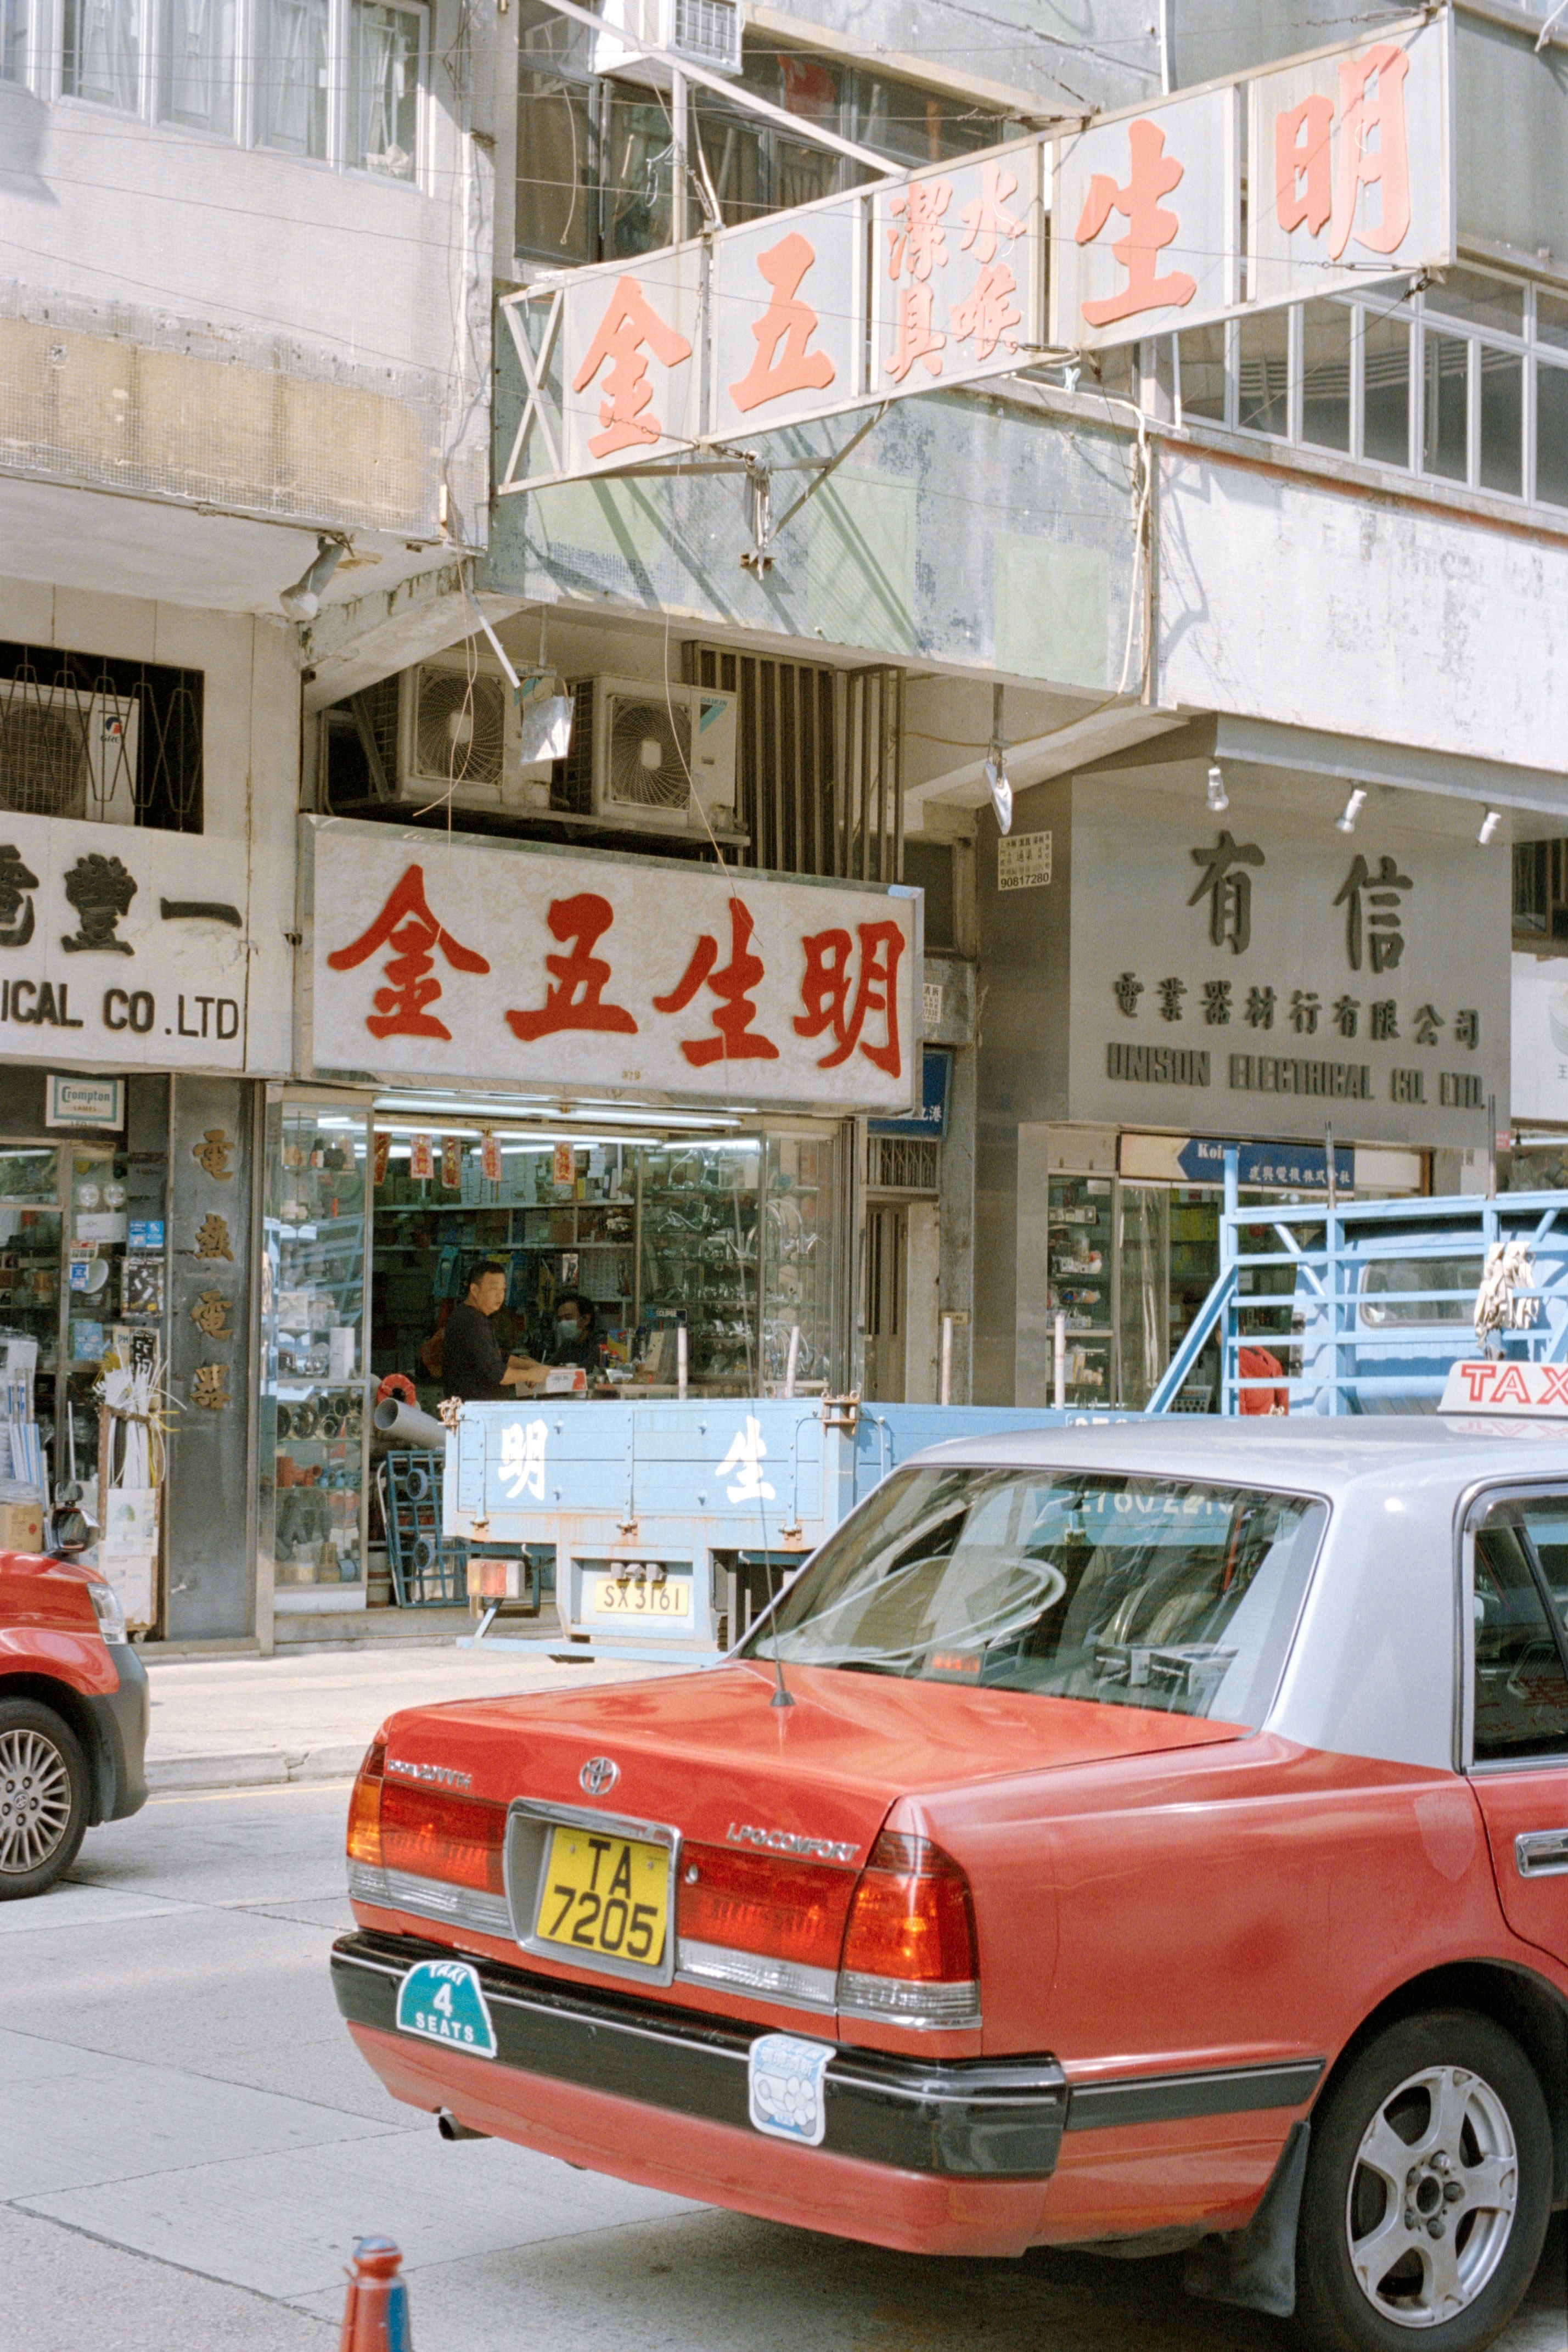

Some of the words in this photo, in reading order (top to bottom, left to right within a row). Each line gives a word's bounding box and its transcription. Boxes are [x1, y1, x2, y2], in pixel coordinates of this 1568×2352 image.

[1001, 873, 1049, 888] 90817280
[1187, 830, 1414, 974] 有信
[1113, 972, 1480, 1050] 電業器材行有限公司
[1108, 1042, 1210, 1087] UNISON
[1229, 1053, 1375, 1100] ELECTRICAL
[61, 1086, 110, 1104] Crompton
[1249, 1165, 1350, 1185] 興電機株式社
[604, 1585, 628, 1608] SX
[635, 1587, 679, 1610] 3161
[588, 1838, 632, 1899] TA
[549, 1886, 658, 1960] 7205
[429, 1964, 468, 1986] TAXI
[433, 1983, 453, 2018] 4
[415, 2012, 474, 2043] SEATS
